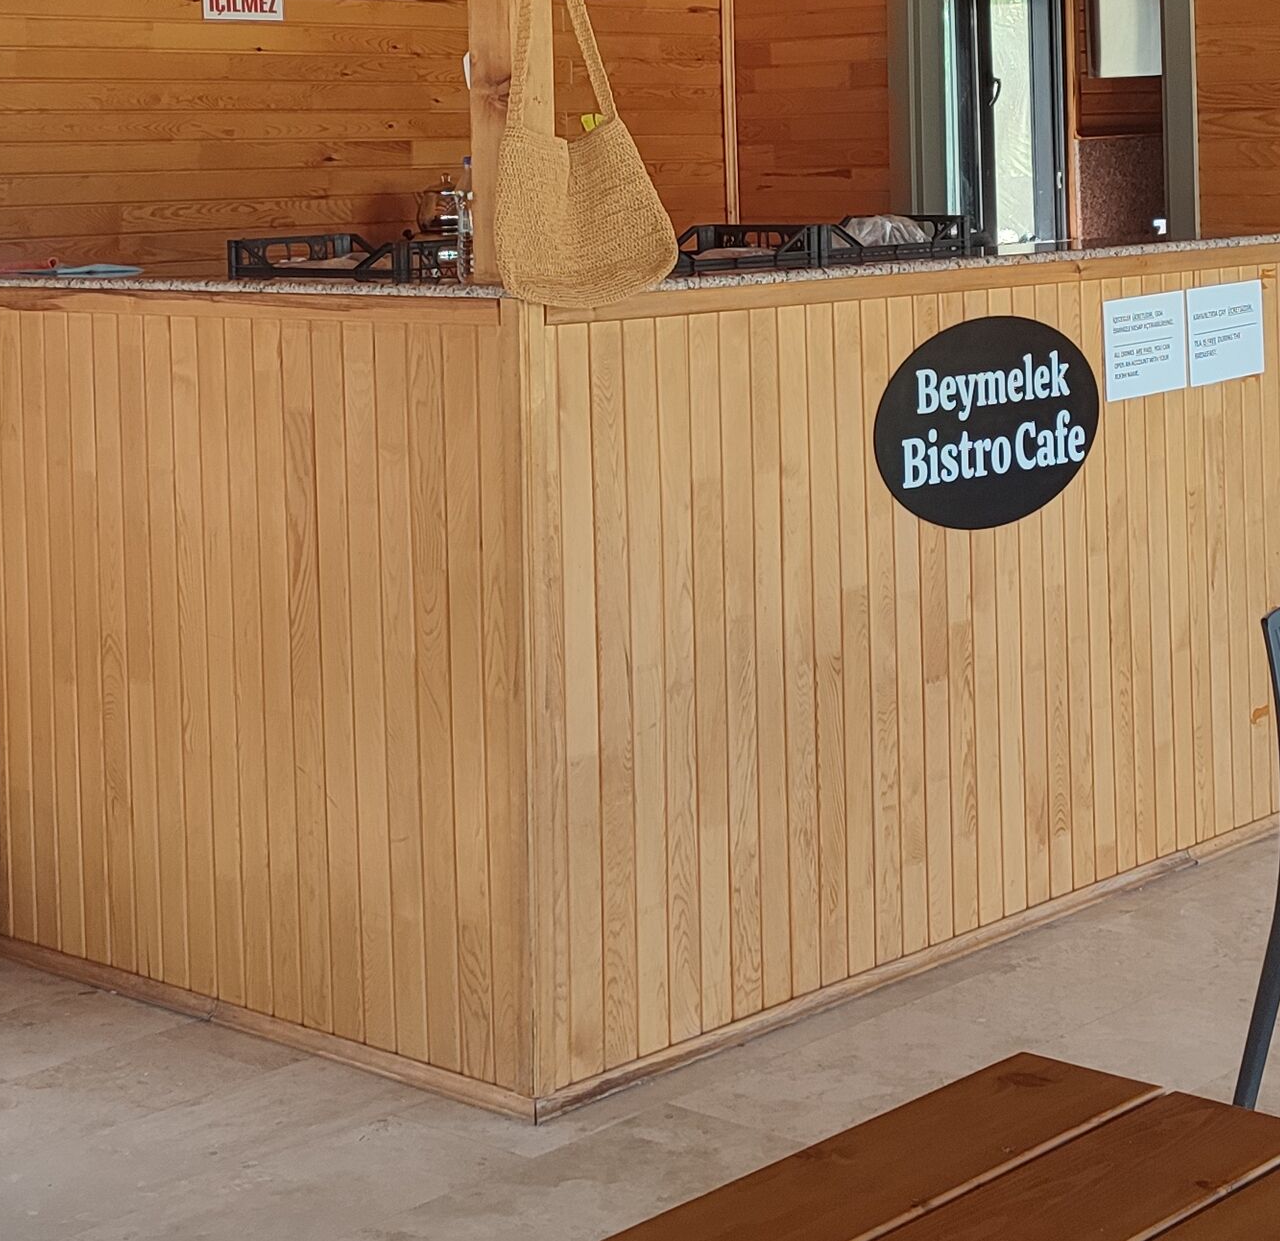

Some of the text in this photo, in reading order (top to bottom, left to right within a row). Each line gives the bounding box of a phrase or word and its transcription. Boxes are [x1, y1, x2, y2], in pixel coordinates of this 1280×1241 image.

[915, 350, 1070, 421] Beymelek
[901, 409, 1086, 489] Bistro Cafe
